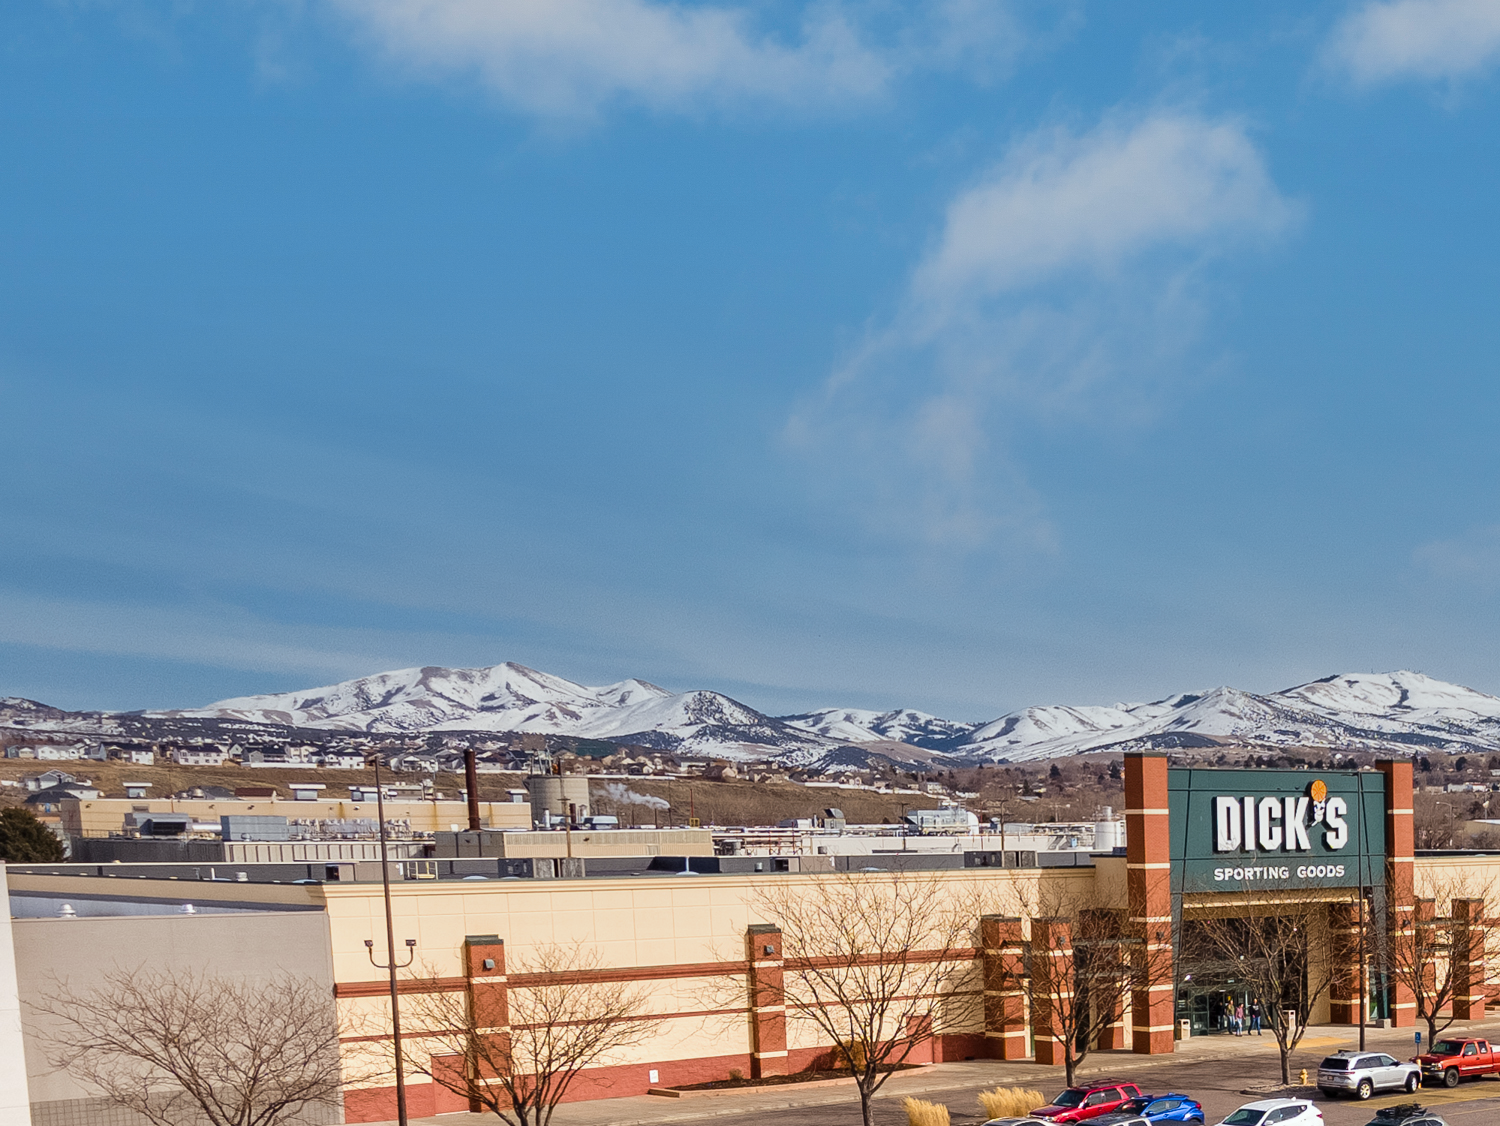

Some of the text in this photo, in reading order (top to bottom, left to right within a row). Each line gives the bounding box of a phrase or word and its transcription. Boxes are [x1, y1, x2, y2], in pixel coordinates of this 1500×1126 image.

[1215, 795, 1348, 851] DICK'S
[1213, 865, 1345, 881] SPORTING GOODS
